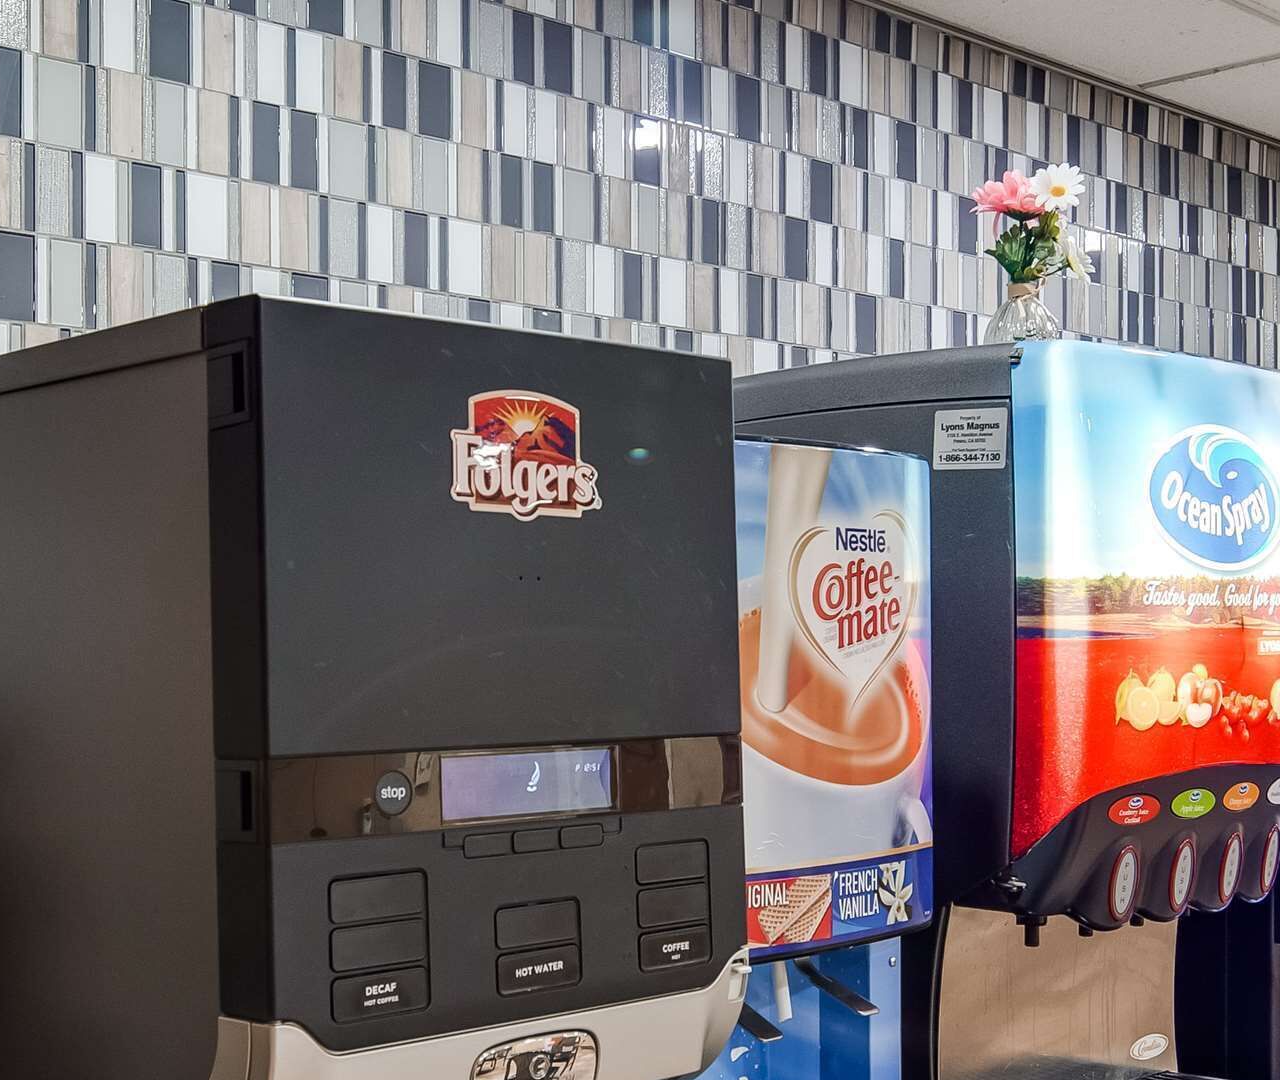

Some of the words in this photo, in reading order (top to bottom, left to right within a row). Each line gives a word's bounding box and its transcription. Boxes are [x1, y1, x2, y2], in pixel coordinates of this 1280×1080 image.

[941, 423, 964, 432] Lyons
[967, 422, 1000, 431] Magnus
[939, 453, 1001, 462] 1-866-344-7130
[453, 432, 596, 512] Folgers
[1161, 470, 1221, 537] Ocean
[1222, 483, 1270, 546] Spray
[1143, 581, 1185, 606] Tastes
[1225, 583, 1253, 606] Good
[1252, 584, 1269, 611] for
[837, 597, 900, 649] mate
[381, 785, 406, 800] stop
[839, 869, 878, 896] FRENCH
[748, 884, 790, 908] IGINAL
[838, 894, 880, 921] VANILLA
[662, 941, 690, 953] COFFEE
[515, 966, 533, 978] HOT
[534, 960, 564, 974] WATER
[365, 982, 397, 996] DECAF
[377, 995, 399, 1005] COFFEE
